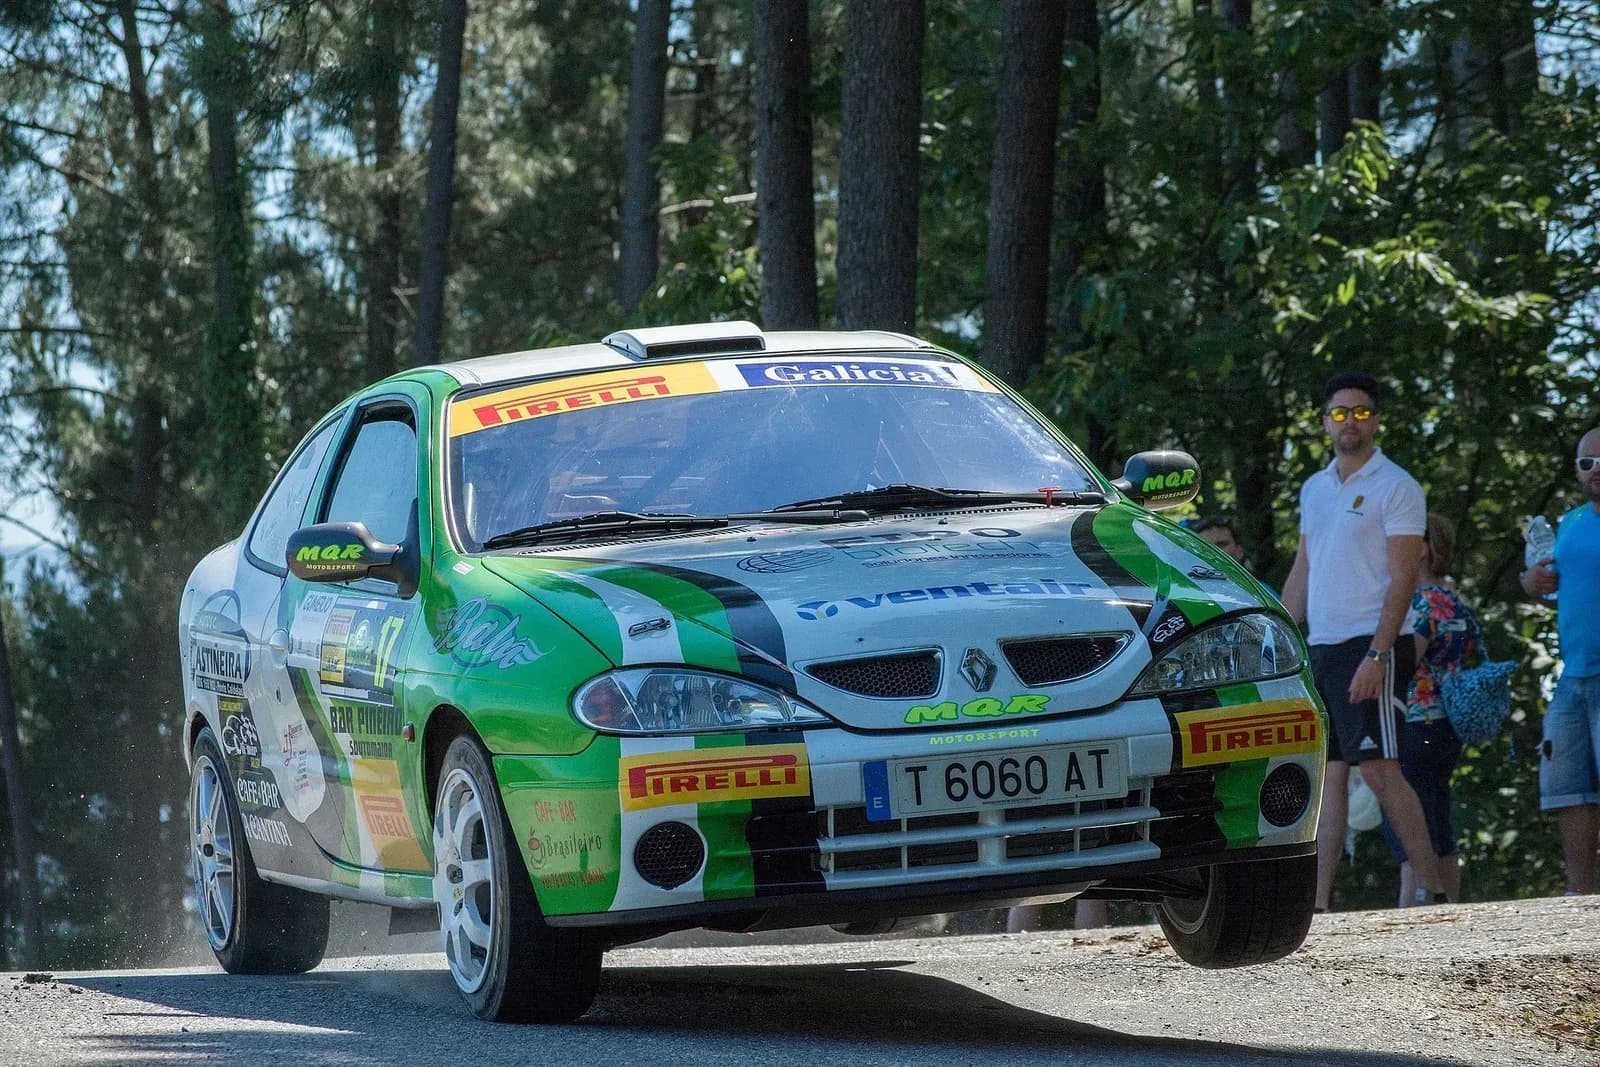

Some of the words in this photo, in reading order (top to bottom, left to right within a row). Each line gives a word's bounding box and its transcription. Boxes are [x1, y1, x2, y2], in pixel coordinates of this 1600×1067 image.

[764, 364, 933, 383] Galicia
[473, 376, 671, 427] PIRELLI
[1142, 469, 1196, 493] MQR
[1152, 489, 1191, 501] MOTORSPORT
[297, 544, 365, 561] MQR
[306, 563, 357, 571] MOTORSPORT
[847, 579, 1092, 609] ventair
[374, 615, 404, 688] 17
[904, 694, 1050, 724] MQR
[929, 728, 1040, 745] MOTORSPORT
[1189, 709, 1316, 754] PIRELLI
[628, 754, 797, 799] PIRELLI
[905, 765, 928, 806] T
[944, 755, 1048, 802] 6060
[1064, 749, 1110, 792] AT
[261, 780, 280, 808] BAR
[873, 797, 884, 809] E
[360, 795, 411, 838] PIRELLI
